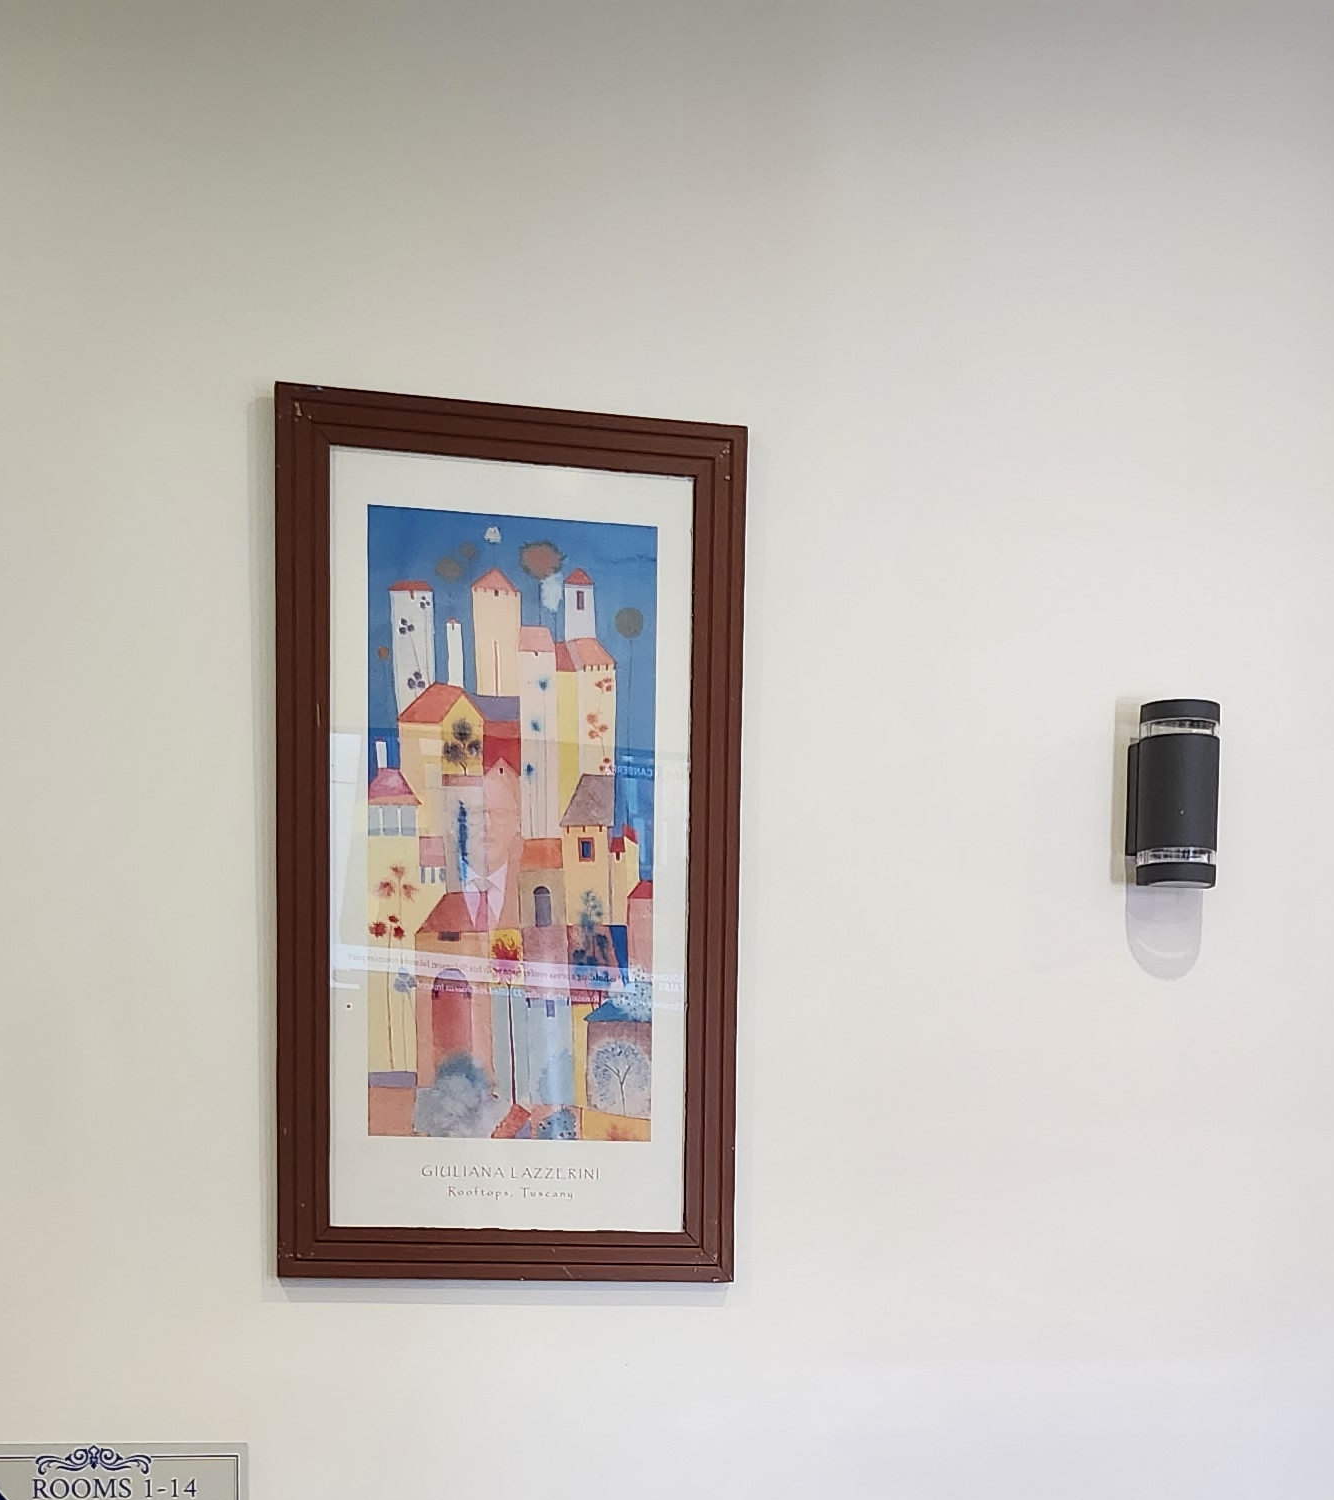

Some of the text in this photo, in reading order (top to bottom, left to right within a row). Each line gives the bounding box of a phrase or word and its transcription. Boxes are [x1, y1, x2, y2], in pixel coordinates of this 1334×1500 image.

[421, 1164, 601, 1181] GIULIANA LAZZERINI
[520, 1186, 574, 1201] Tuscany
[31, 1477, 198, 1500] ROOMS 1-14
